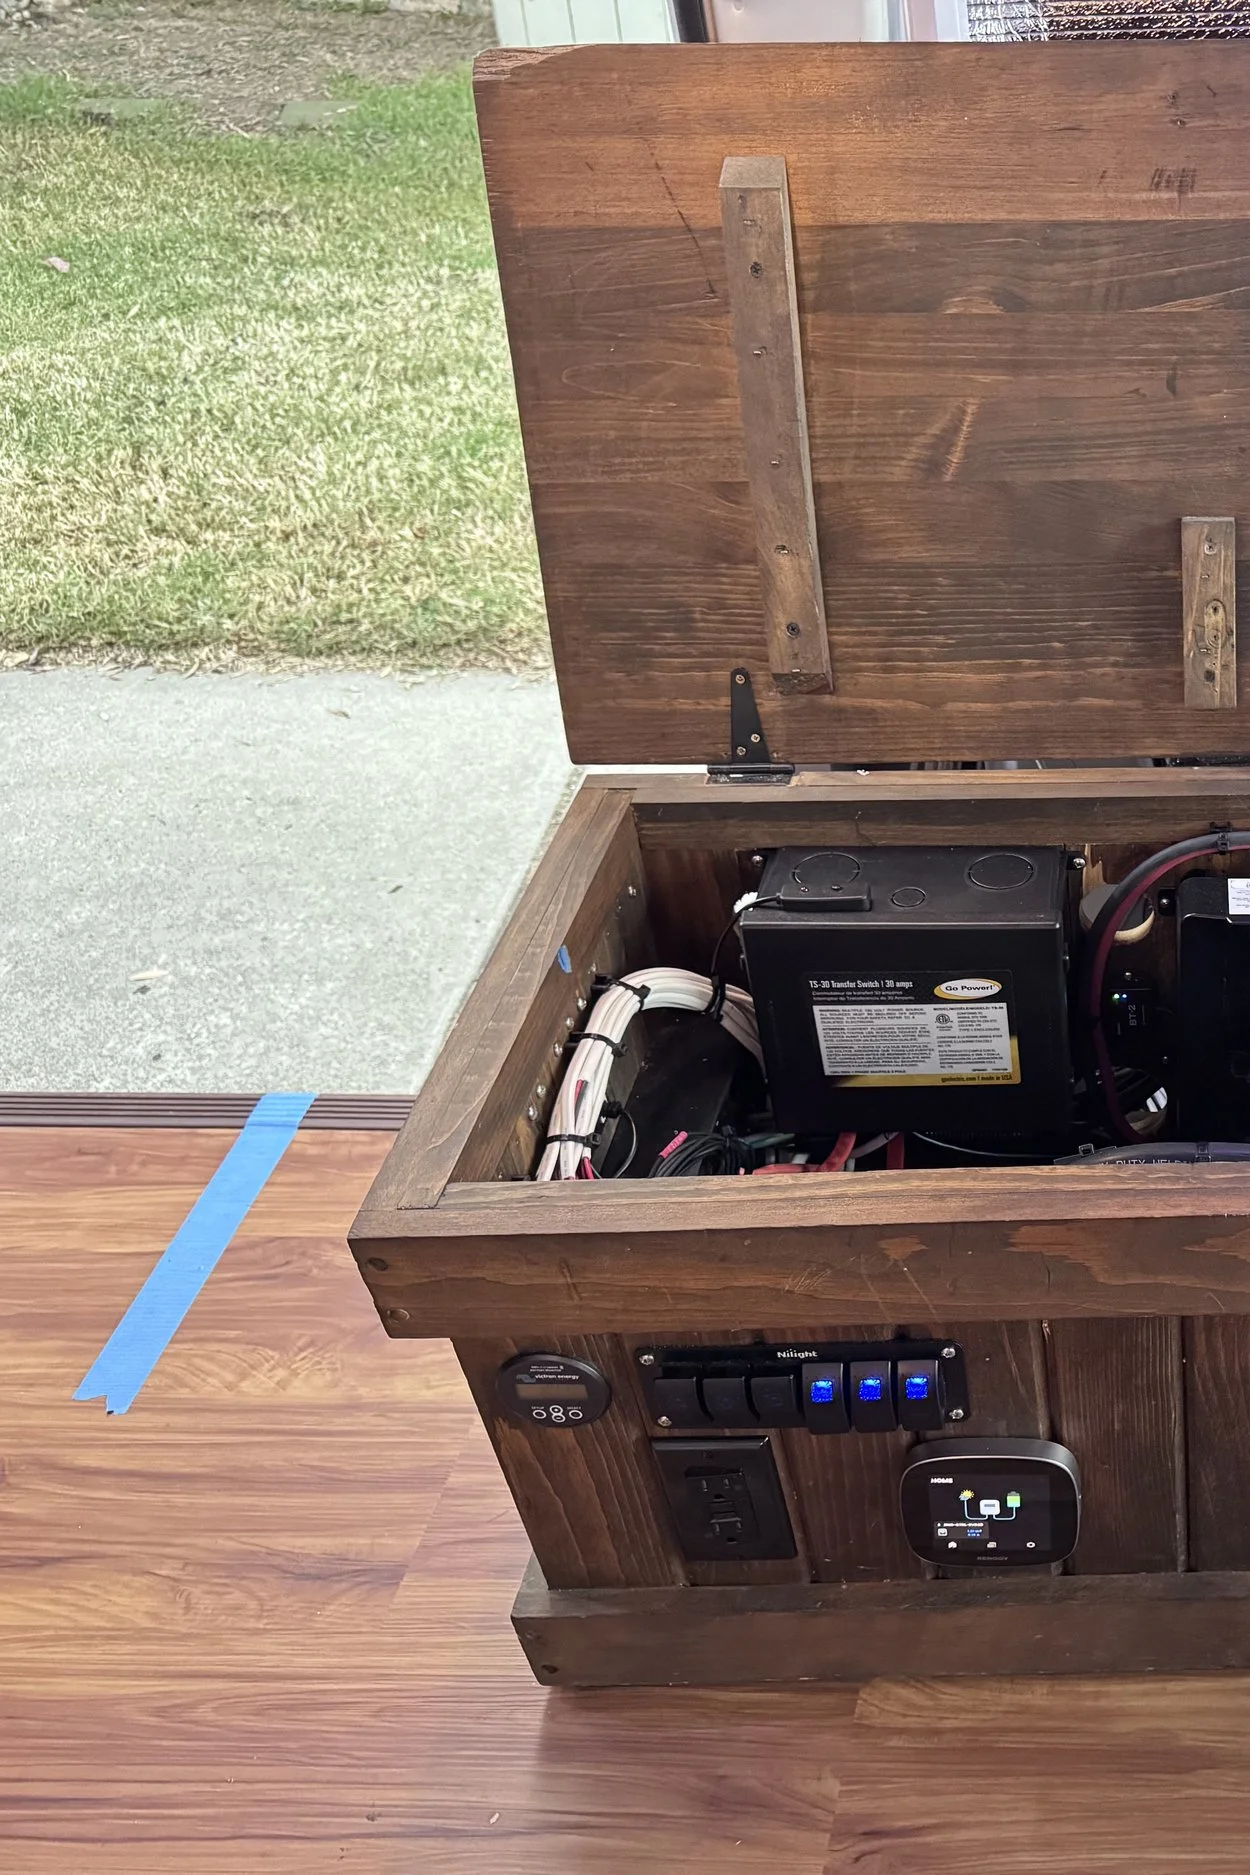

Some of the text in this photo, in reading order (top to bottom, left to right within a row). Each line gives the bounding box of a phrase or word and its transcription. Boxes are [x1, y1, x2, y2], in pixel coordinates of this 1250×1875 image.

[831, 980, 856, 988] Transfer
[857, 979, 879, 988] Switch
[885, 980, 894, 988] 30
[895, 981, 913, 989] amps
[777, 1348, 818, 1359] Nilight
